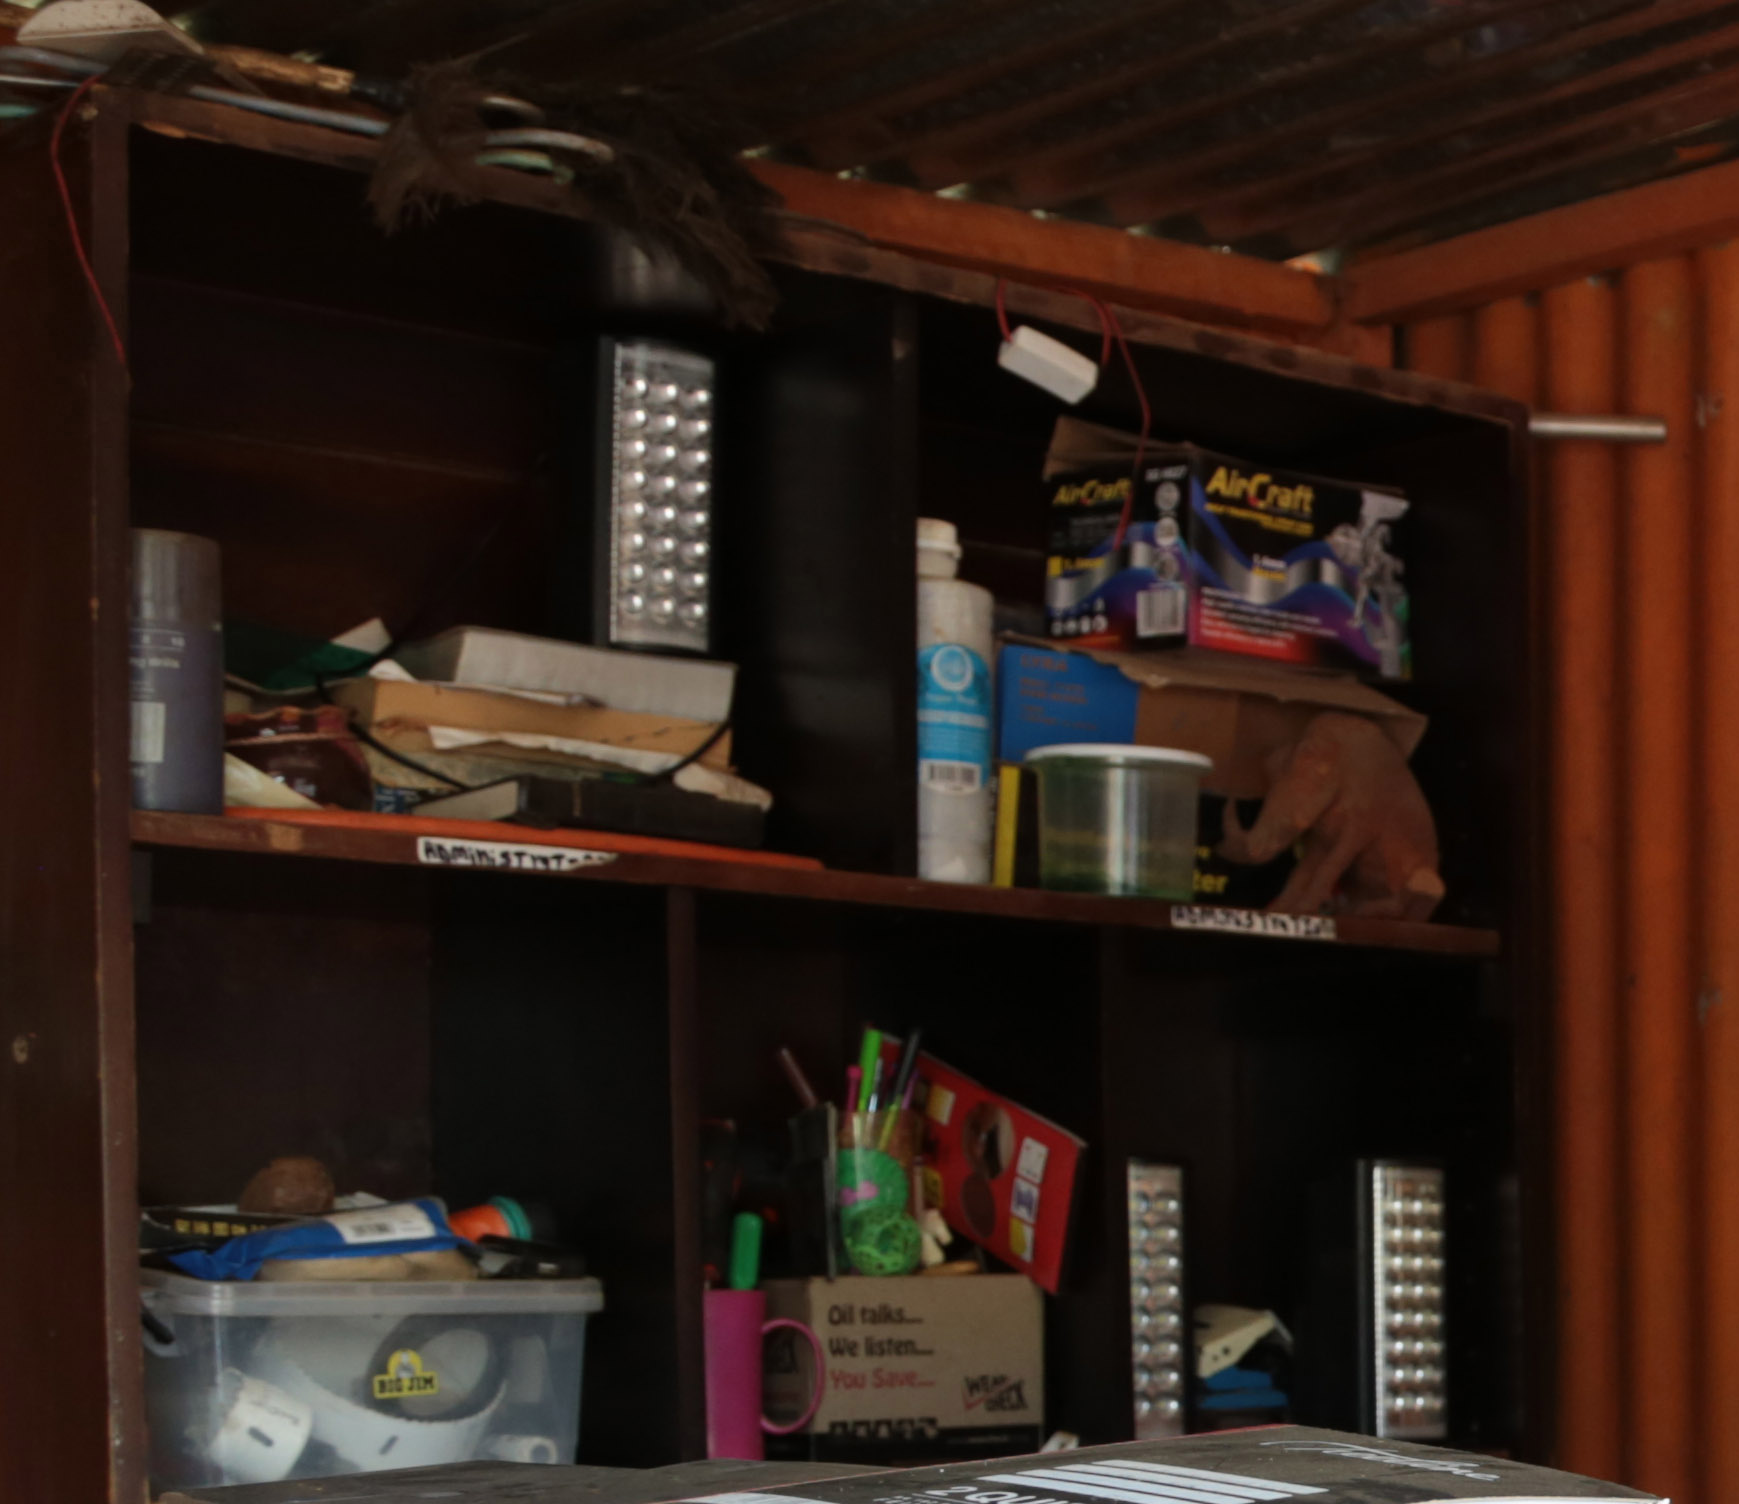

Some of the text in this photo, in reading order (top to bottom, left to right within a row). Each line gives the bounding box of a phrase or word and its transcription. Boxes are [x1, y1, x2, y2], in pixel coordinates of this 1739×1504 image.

[1205, 465, 1315, 513] AirCraft
[828, 1304, 855, 1325] Oil
[829, 1337, 858, 1357] We
[406, 1374, 436, 1392] JIM
[831, 1369, 867, 1390] You
[925, 1485, 978, 1497] 2
